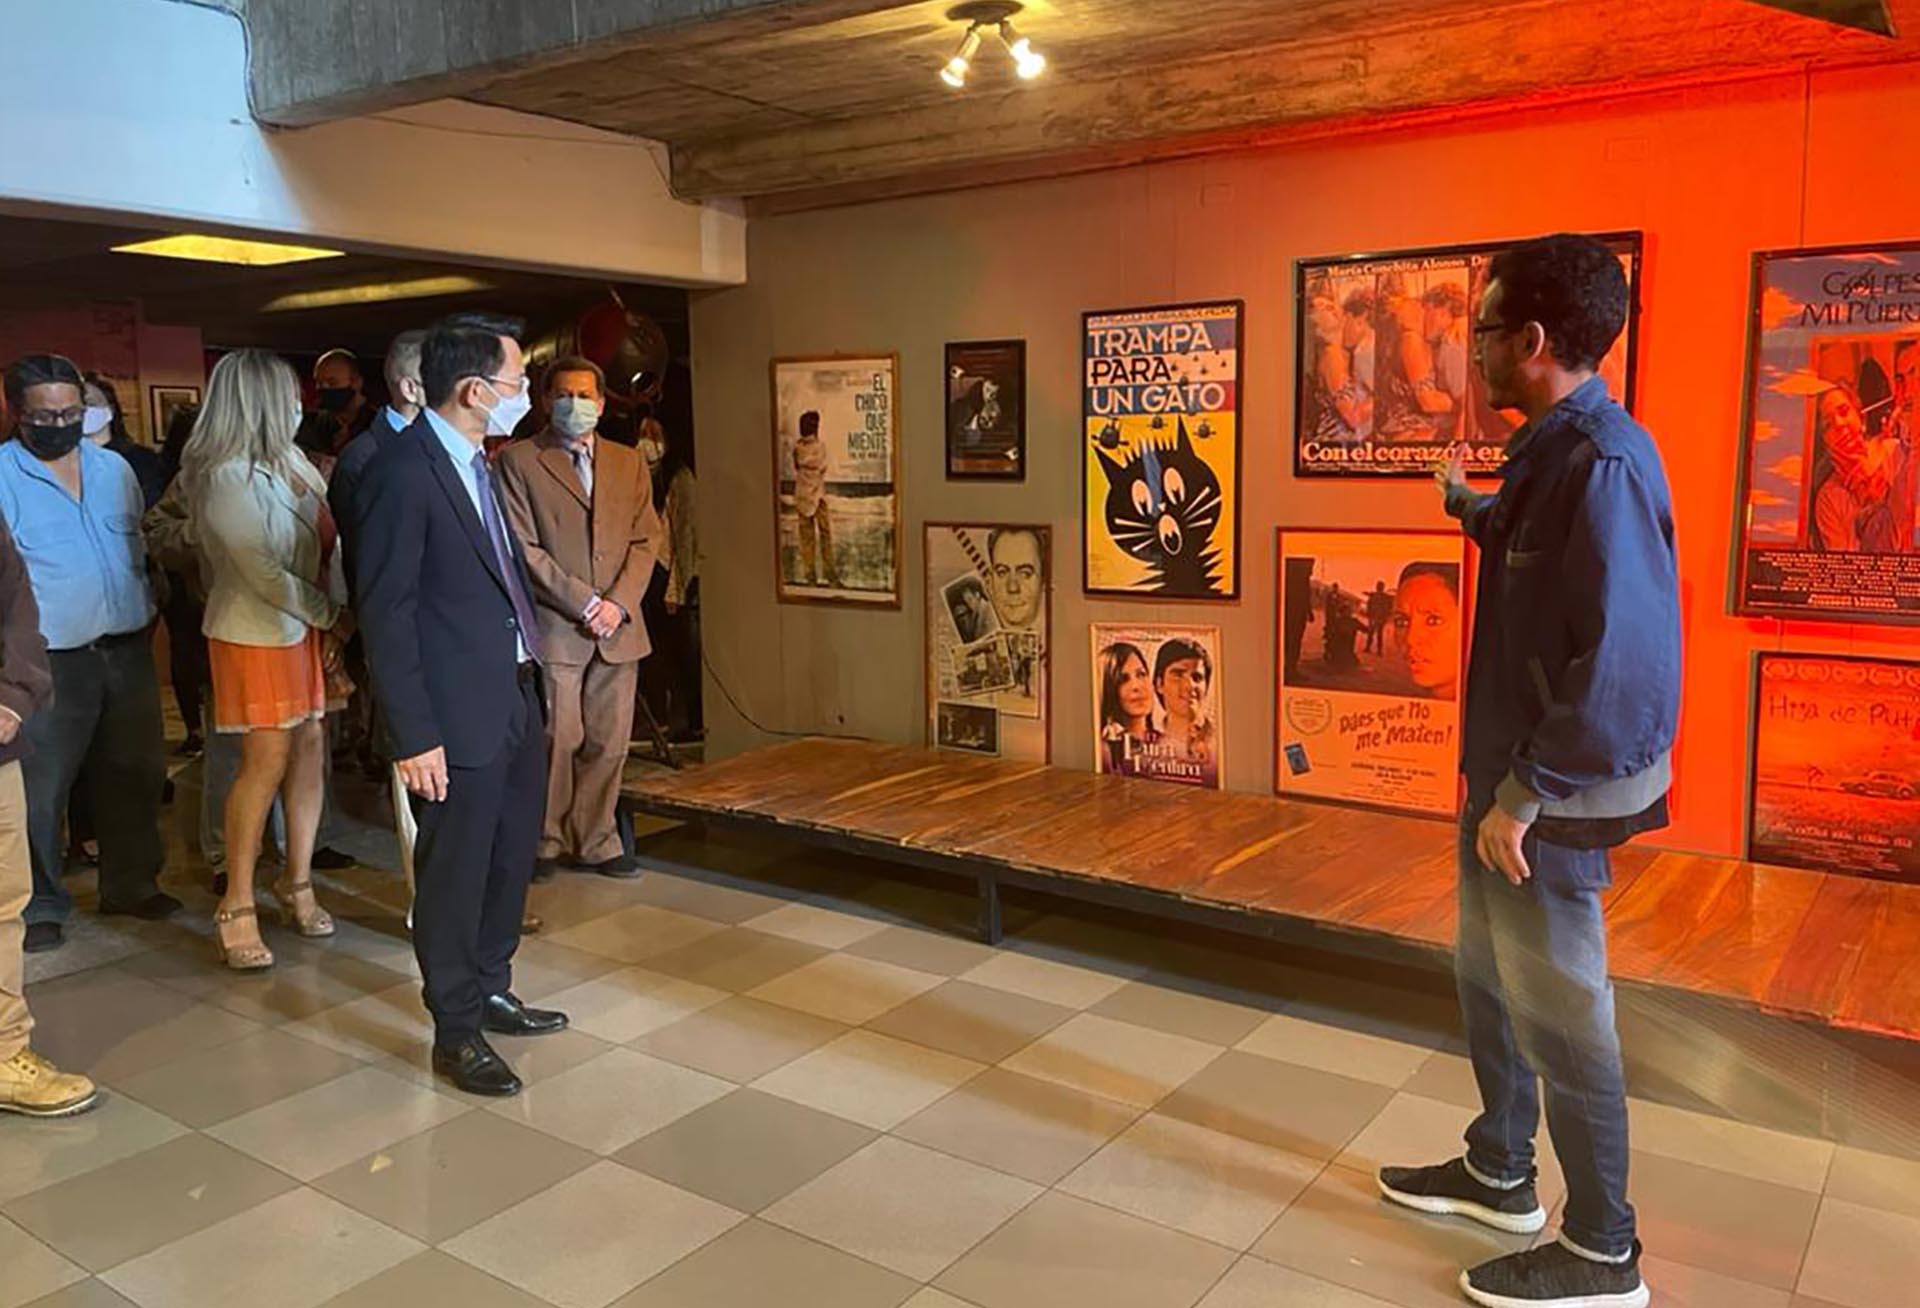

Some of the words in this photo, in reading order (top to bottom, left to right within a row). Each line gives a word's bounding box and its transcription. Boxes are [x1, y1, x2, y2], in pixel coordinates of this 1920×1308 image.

[1800, 302, 1840, 327] MI
[1088, 321, 1213, 356] TRAMPA
[1091, 356, 1172, 384] PARA
[873, 373, 886, 392] EL
[855, 393, 887, 412] CHICO
[1092, 387, 1134, 414] UN
[1141, 383, 1226, 413] GATO
[866, 412, 887, 432] QUE
[847, 432, 887, 451] MIENTE
[1303, 442, 1348, 461] Con
[1350, 441, 1373, 461] el
[1377, 705, 1405, 730] que
